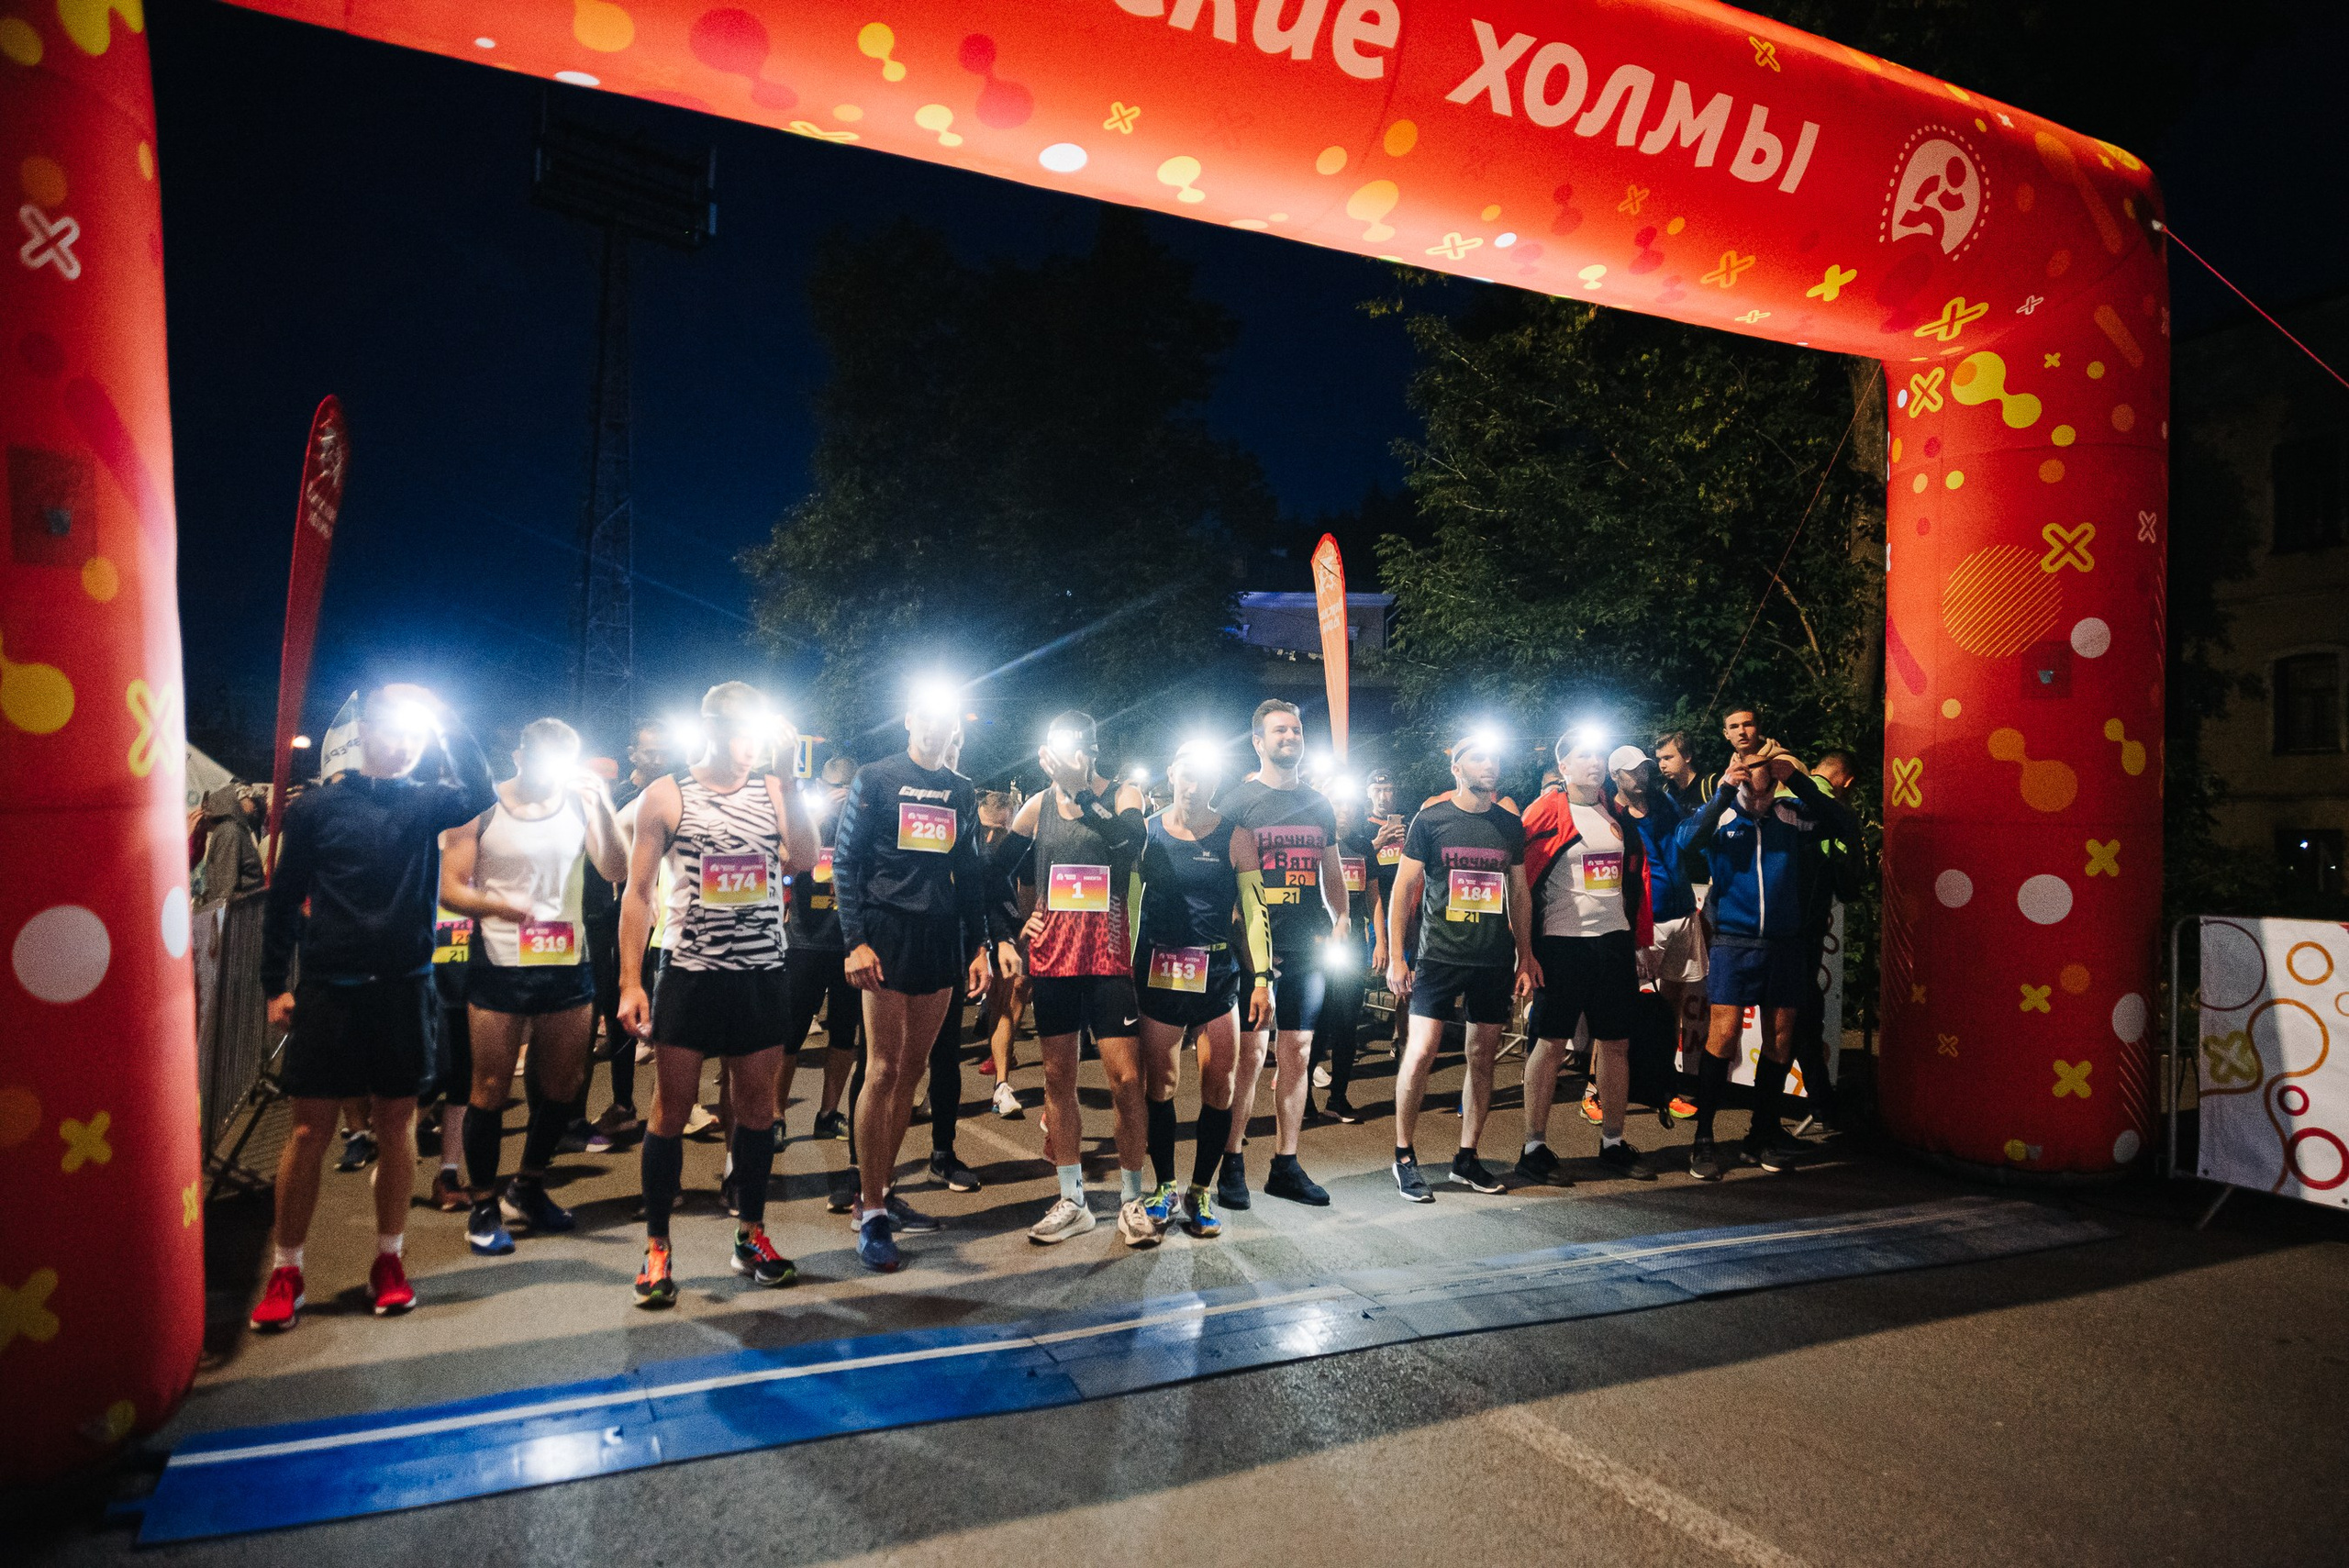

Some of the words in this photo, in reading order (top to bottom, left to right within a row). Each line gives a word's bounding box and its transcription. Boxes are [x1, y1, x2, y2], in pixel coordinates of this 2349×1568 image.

[1114, 0, 1400, 80] ие
[911, 821, 947, 841] 226
[1274, 851, 1319, 871] Вятк
[1379, 847, 1401, 859] 307
[1288, 873, 1307, 886] 20
[1592, 865, 1619, 881] 129
[717, 873, 757, 892] 174
[1072, 882, 1085, 898] 1
[1282, 891, 1297, 904] 21
[1461, 885, 1493, 902] 184
[1464, 911, 1477, 923] 21
[530, 936, 567, 953] 319
[450, 951, 465, 962] 21
[1160, 962, 1197, 980] 153
